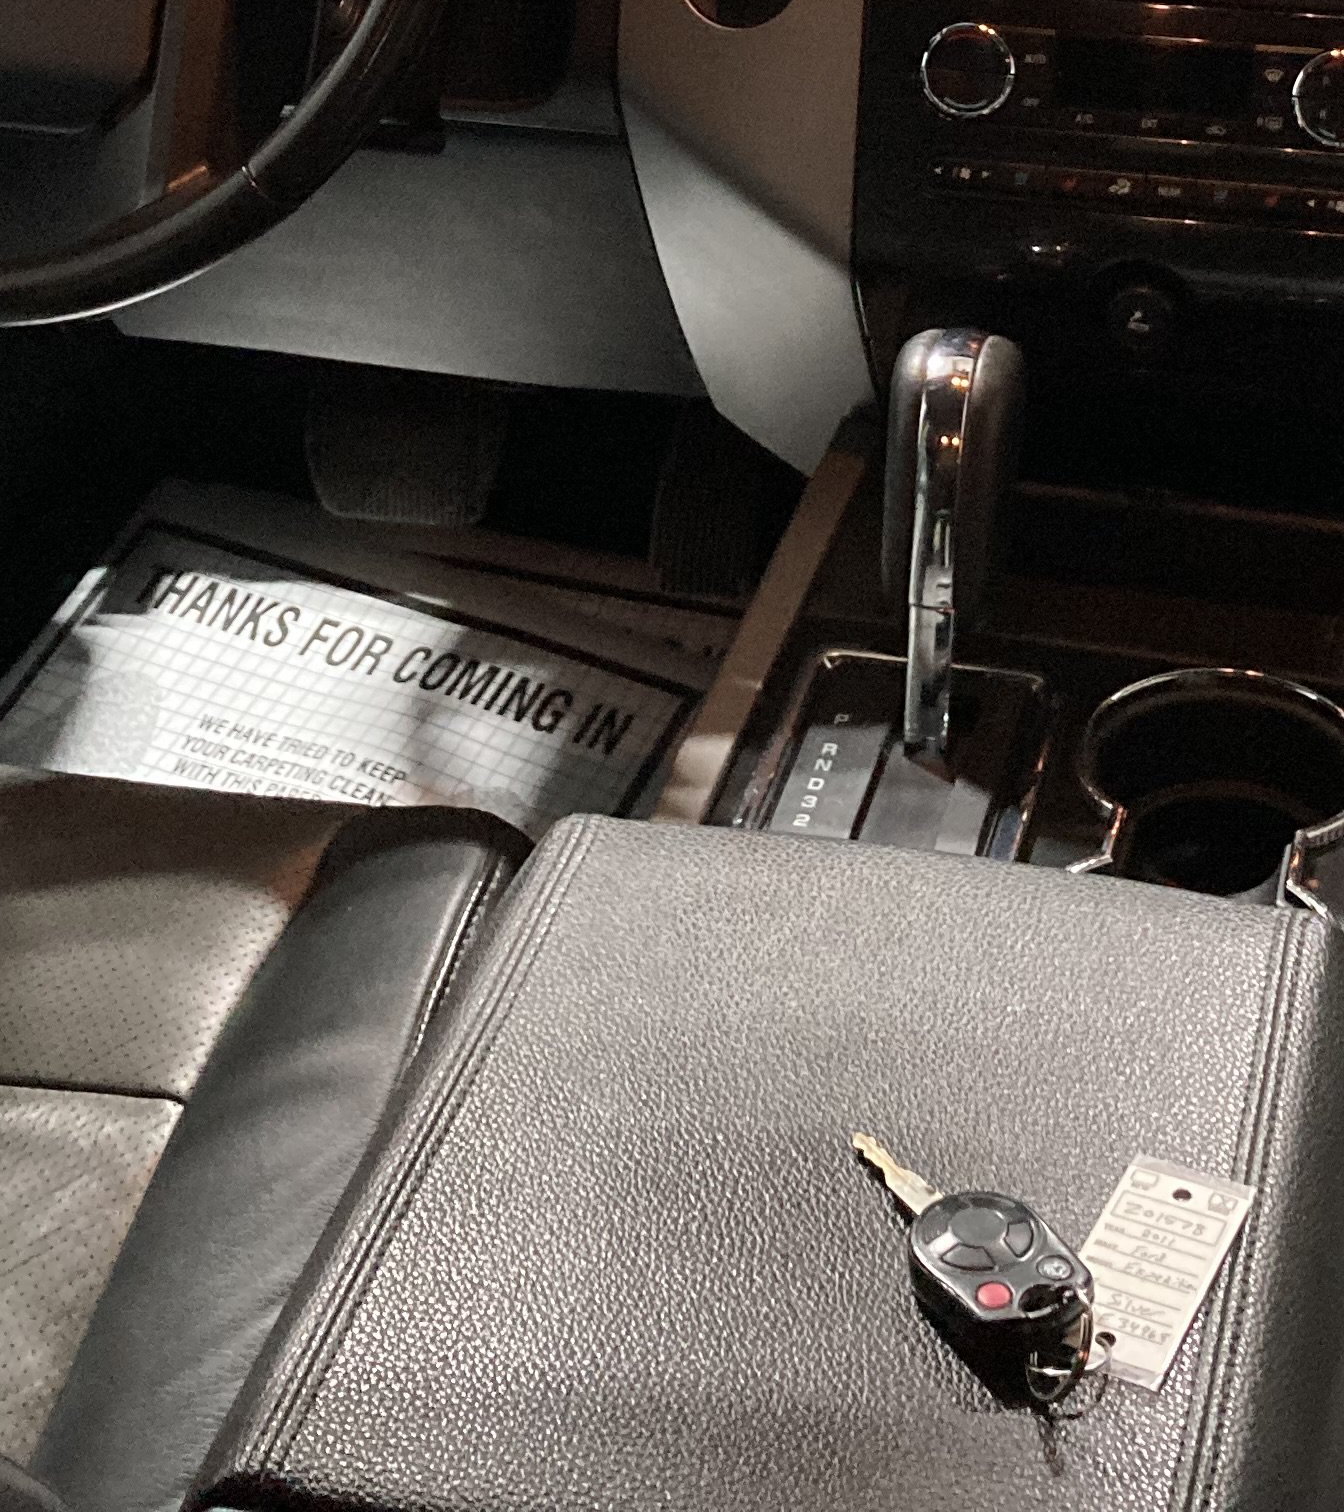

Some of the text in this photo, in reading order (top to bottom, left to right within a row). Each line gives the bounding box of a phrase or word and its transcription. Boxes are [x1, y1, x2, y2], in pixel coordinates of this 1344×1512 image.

[135, 567, 636, 756] THANKS FOR COMING IN
[834, 713, 851, 725] P
[198, 713, 407, 785] WE HAVE TRIED TO KEEP
[821, 742, 838, 756] R
[181, 734, 231, 761] YOUR
[231, 748, 327, 785] CARPETING
[815, 758, 833, 771] N
[172, 757, 218, 786] WITH
[221, 771, 264, 797] THIS
[807, 777, 825, 791] D
[800, 794, 818, 808] 3
[792, 813, 811, 827] 2
[1124, 1201, 1206, 1237] 201578
[1129, 1245, 1167, 1262] Ford
[1107, 1293, 1166, 1317] Silver
